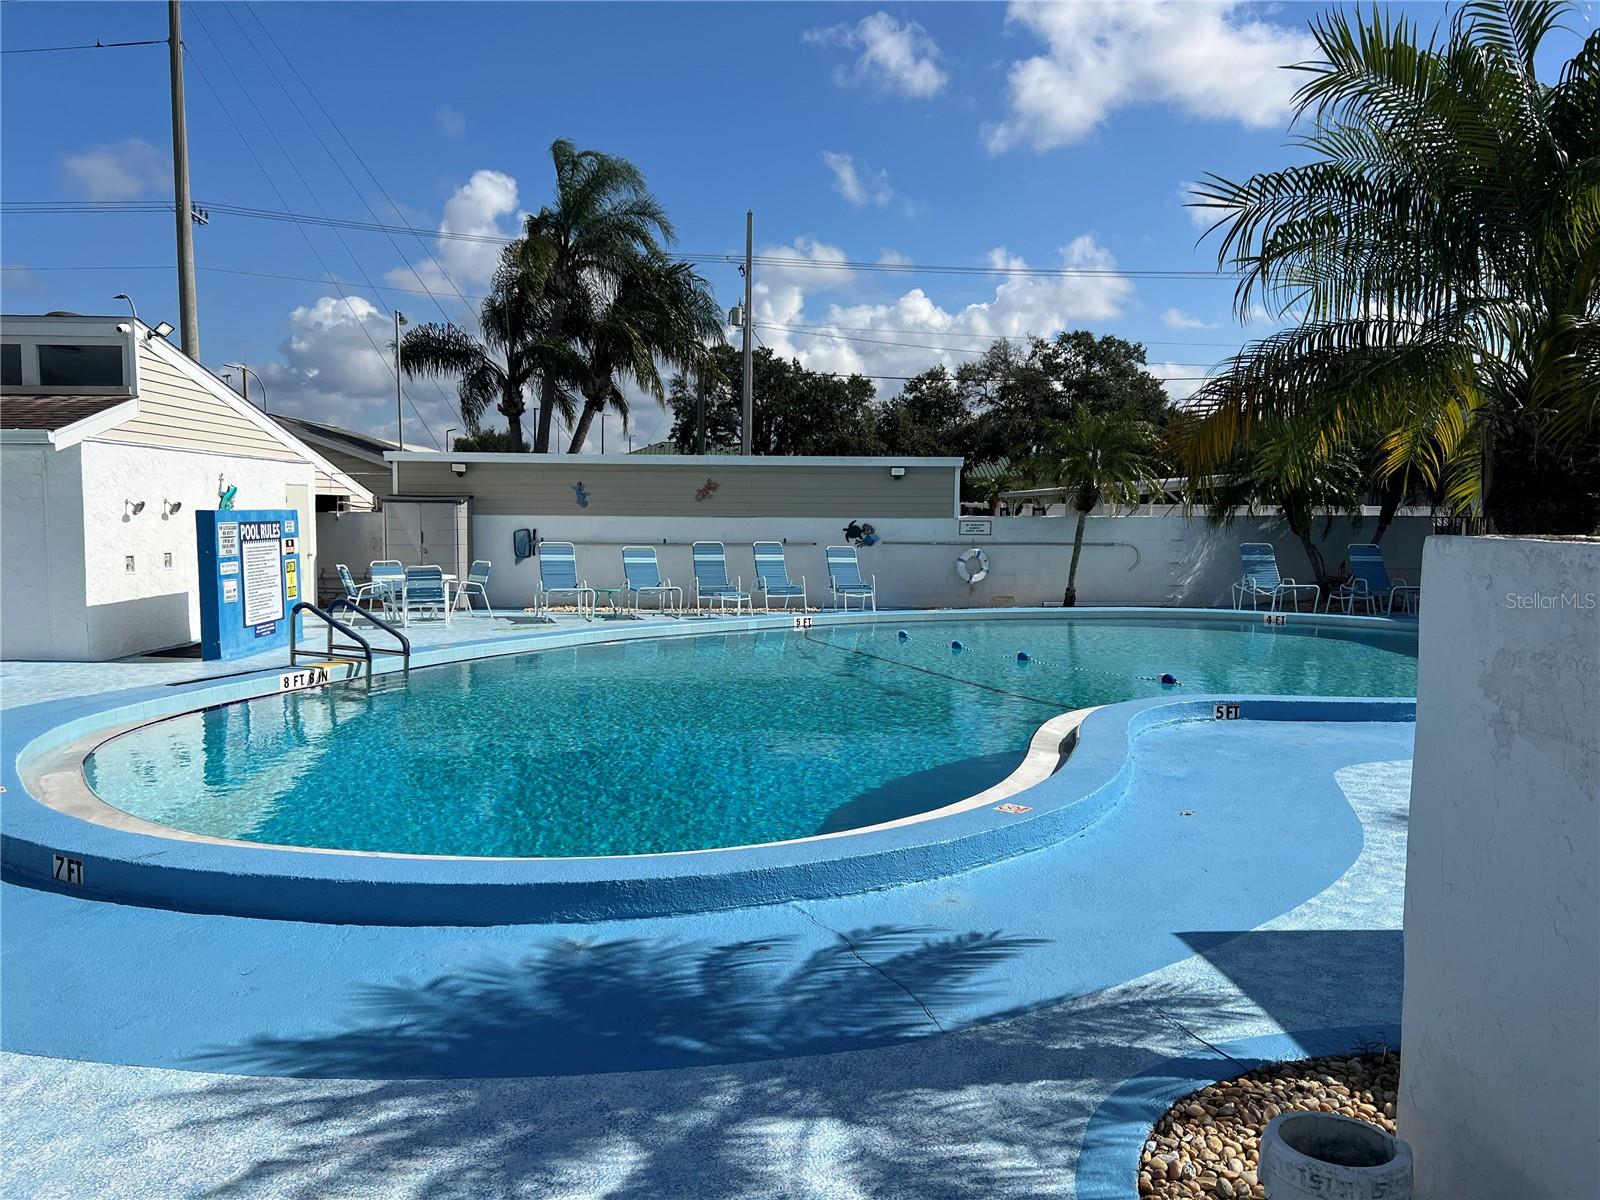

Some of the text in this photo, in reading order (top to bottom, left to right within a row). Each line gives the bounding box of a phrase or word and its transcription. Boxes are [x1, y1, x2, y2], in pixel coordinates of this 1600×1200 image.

[240, 524, 260, 541] POOL
[260, 523, 281, 539] RULES
[796, 617, 812, 628] 5 FT
[1266, 615, 1286, 626] 4 FT
[283, 670, 328, 689] 8 FT 6 IN
[1215, 705, 1240, 720] 5 FT
[55, 855, 83, 884] 7 FT
